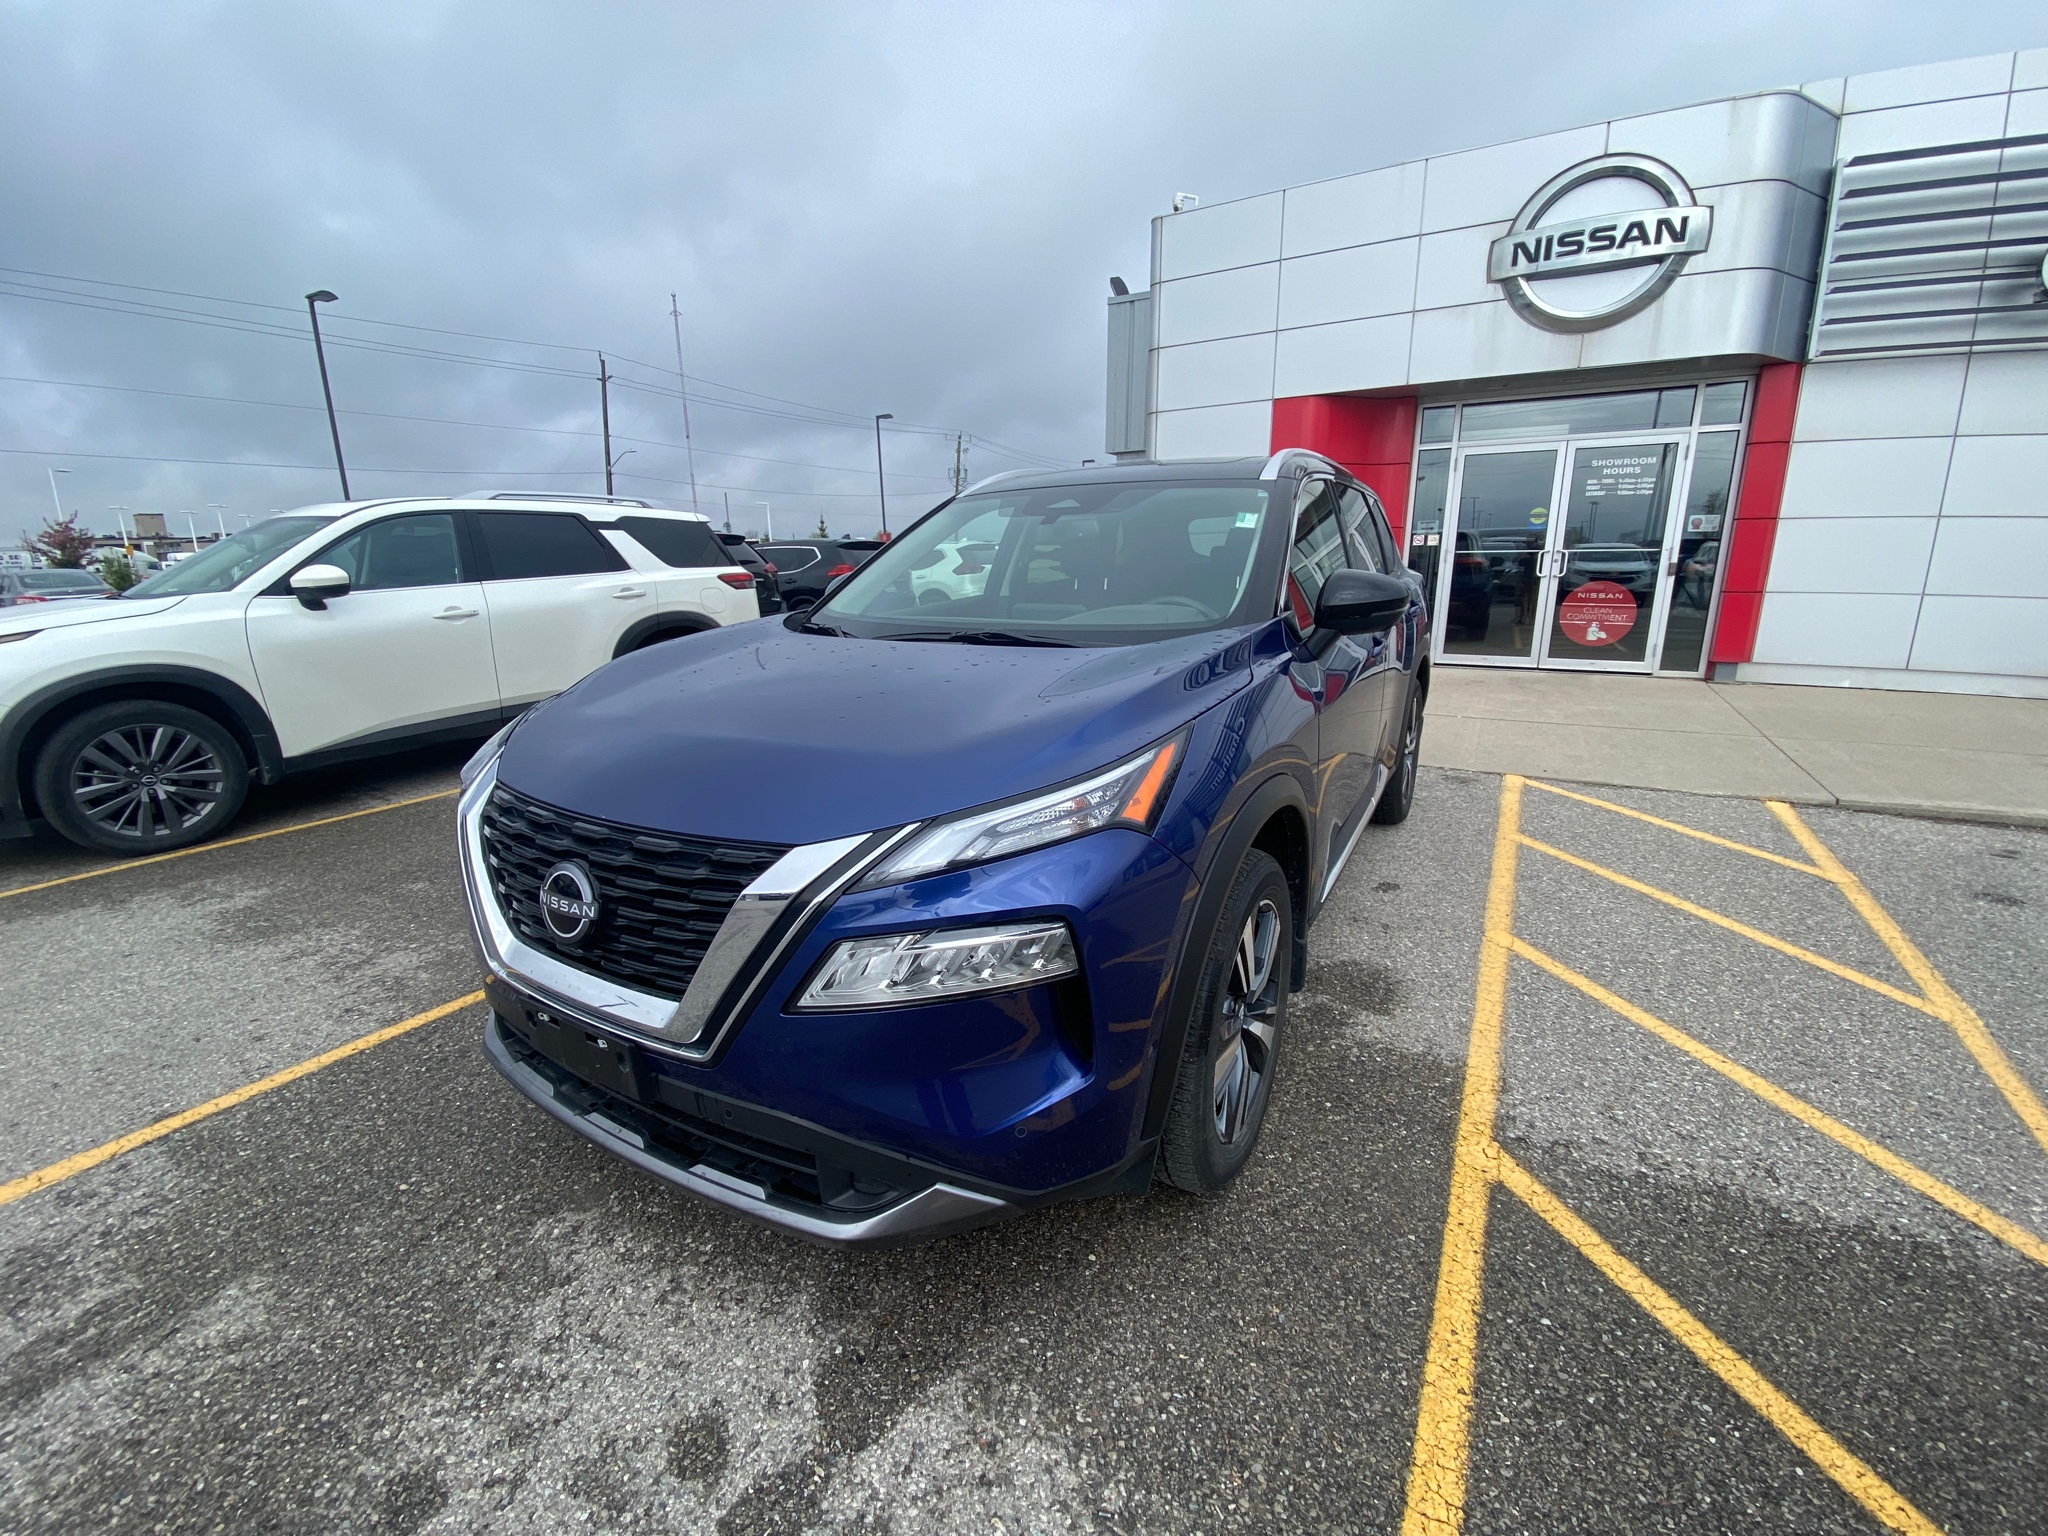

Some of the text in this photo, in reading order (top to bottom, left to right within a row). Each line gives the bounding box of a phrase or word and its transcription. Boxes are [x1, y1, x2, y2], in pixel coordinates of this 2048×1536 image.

[1511, 216, 1690, 267] NISSAN
[1591, 457, 1657, 466] SHOWROOM
[1603, 466, 1641, 475] HOURS
[1583, 606, 1613, 614] CLEAN
[1566, 613, 1628, 621] COMMITMENT
[540, 890, 595, 917] NISSAN
